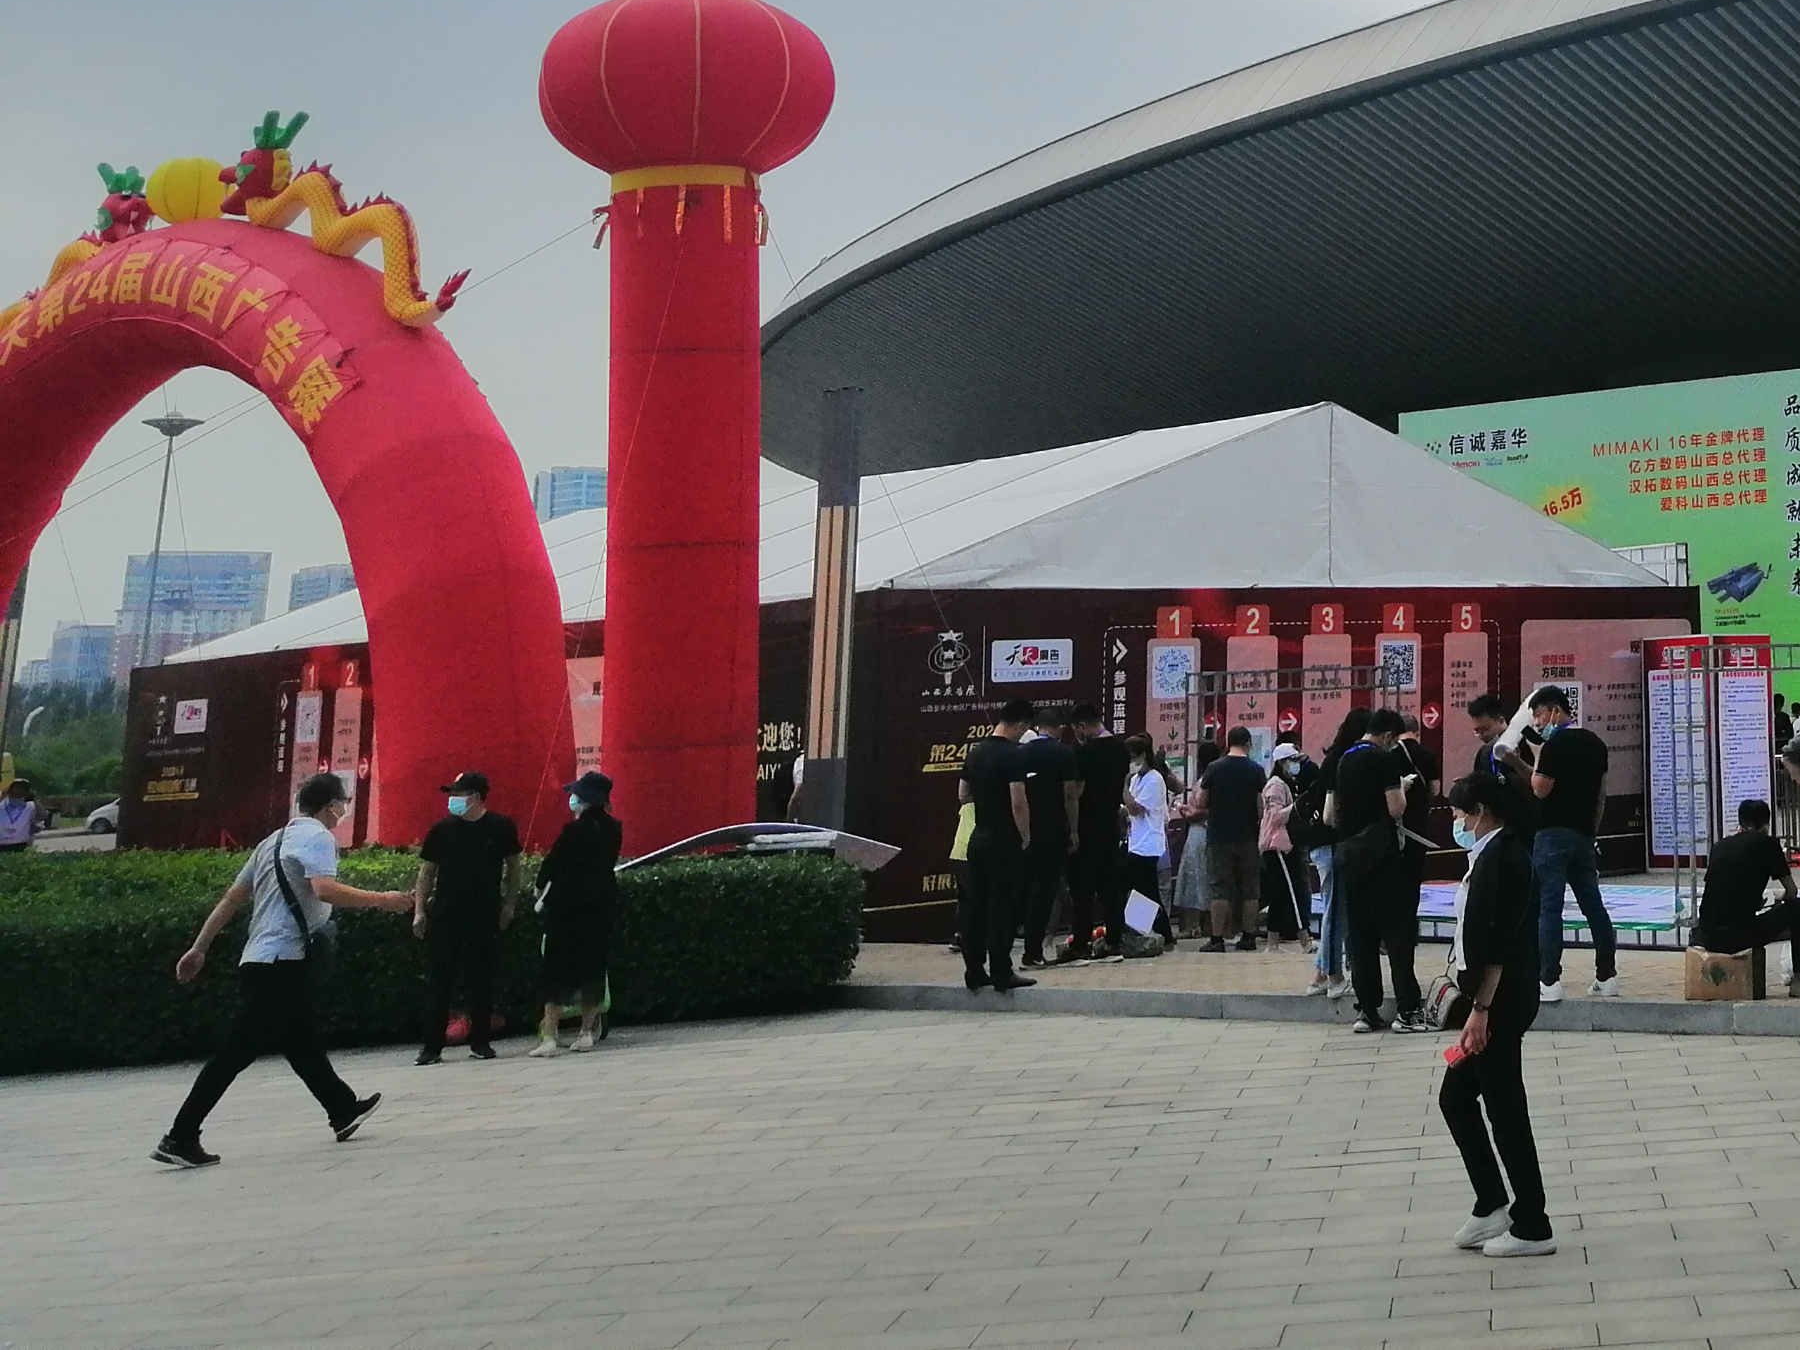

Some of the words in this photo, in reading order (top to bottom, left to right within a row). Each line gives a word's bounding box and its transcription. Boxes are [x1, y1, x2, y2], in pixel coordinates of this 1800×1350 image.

[1448, 428, 1528, 455] 信诚嘉华
[1593, 437, 1659, 457] MIMAKI
[1668, 427, 1766, 450] 16年金牌代理
[1629, 447, 1766, 475] 亿方数码山西总代理
[1629, 468, 1767, 494] 汉拓数码山西总代理
[1543, 487, 1583, 516] 16.5万
[1660, 488, 1767, 512] 爱科山西总代理
[1169, 609, 1180, 636] 1
[1246, 607, 1260, 634] 2
[1321, 607, 1334, 632] 3
[1392, 606, 1405, 631] 4
[1460, 606, 1472, 630] 5
[346, 662, 354, 686] 2
[1113, 670, 1127, 735] 参观流程
